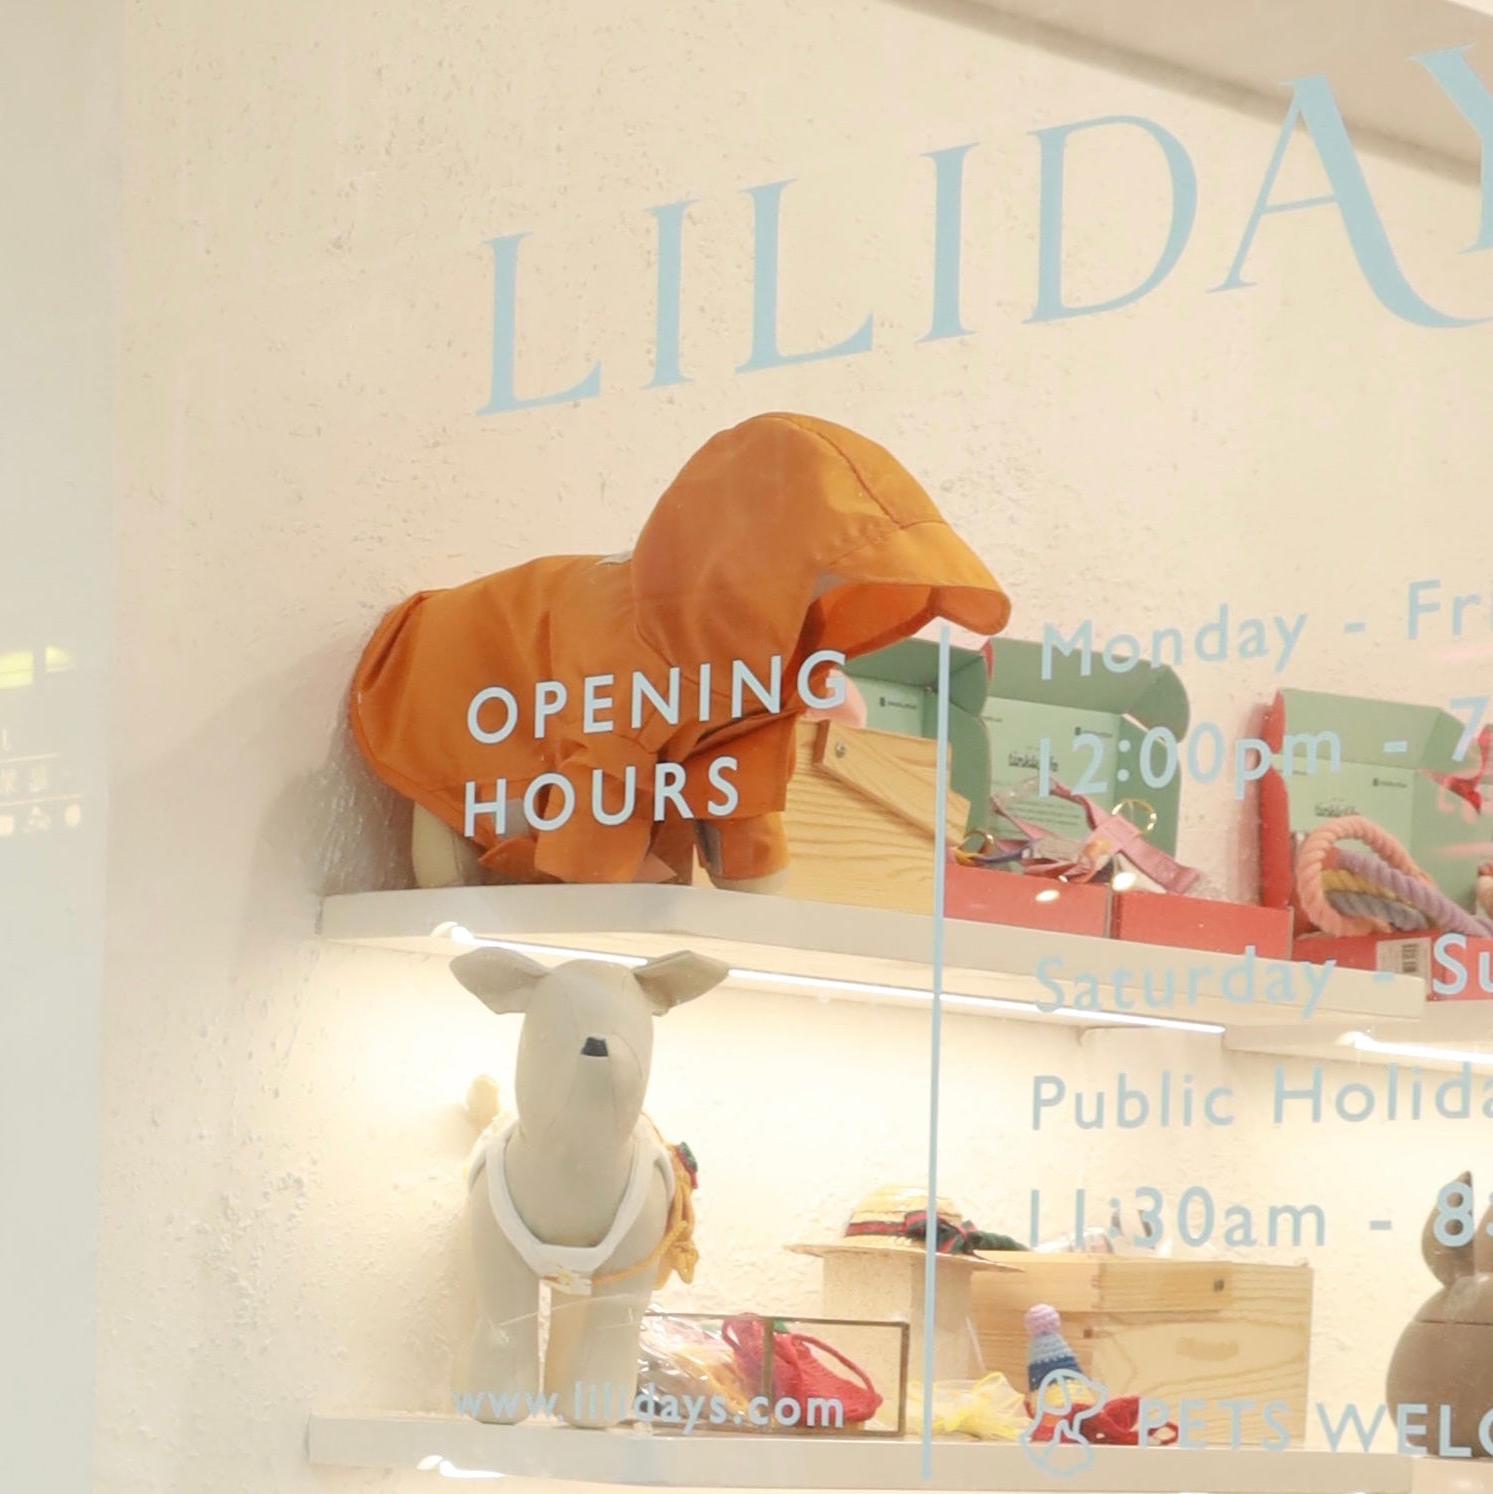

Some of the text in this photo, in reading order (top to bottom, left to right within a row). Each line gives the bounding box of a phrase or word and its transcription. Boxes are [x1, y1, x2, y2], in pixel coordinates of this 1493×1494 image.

[1040, 602, 1309, 681] Monday
[1407, 578, 1493, 640] Fr
[466, 649, 847, 745] OPENING
[463, 756, 740, 838] HOURS
[1037, 721, 1342, 800] 12:00pm
[1033, 945, 1338, 1019] Saturday
[1031, 1070, 1235, 1131] Public
[1028, 1185, 1326, 1248] 11:30am
[452, 1380, 845, 1436] www.lilidays.com
[1136, 1397, 1292, 1453] PETS
